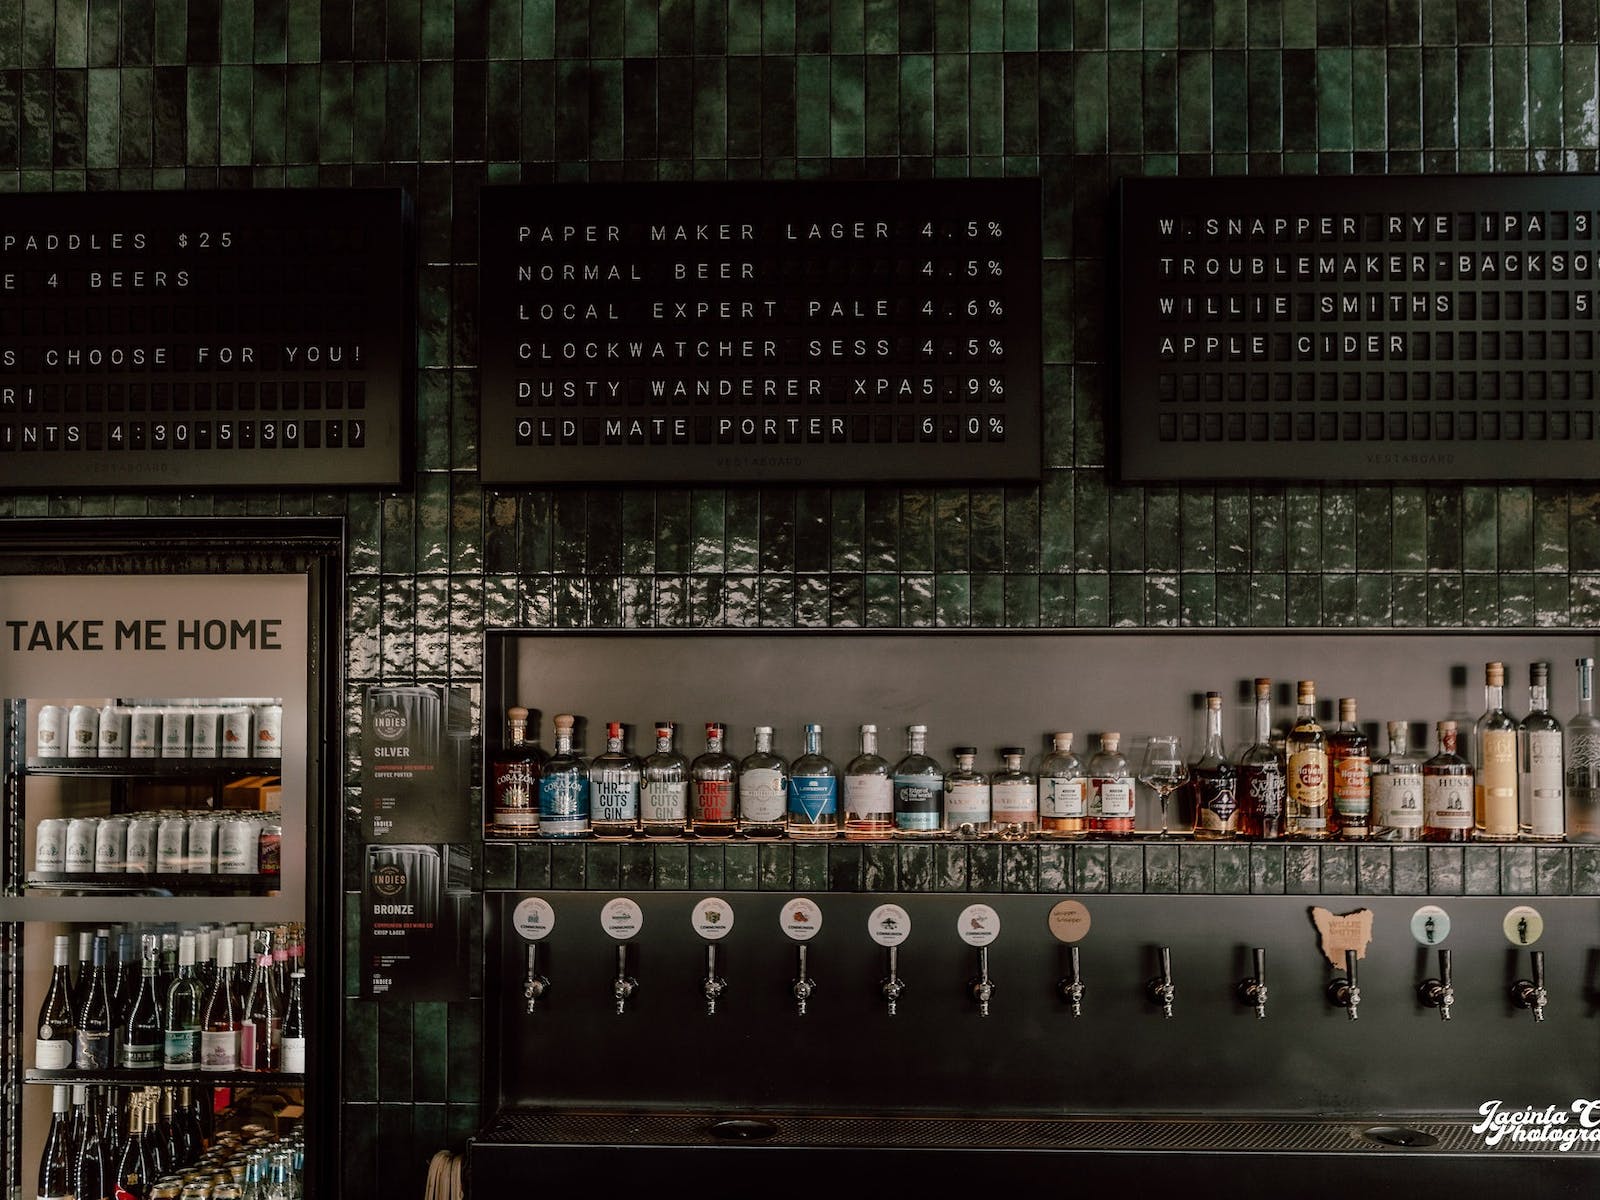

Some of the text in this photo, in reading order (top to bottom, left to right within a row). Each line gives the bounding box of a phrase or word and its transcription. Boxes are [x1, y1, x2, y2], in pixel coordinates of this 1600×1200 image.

[520, 221, 1004, 242] PAPER MAKER LAGER 4.5%
[1159, 215, 1588, 235] W.SNAPPER RYE IPA 3
[4, 232, 232, 250] PADDLES $25
[519, 260, 1004, 281] NORMAL BEER 4.5%
[1160, 255, 1600, 275] TROUBLEMAKER-BACKSO
[47, 273, 58, 288] 4
[91, 271, 189, 288] BEERS
[519, 299, 1004, 320] LOCAL EXPERT PALE 4.6%
[1159, 295, 1588, 314] WILLIE SMITHS 5
[519, 338, 1004, 359] CLOCKWATCHER SESS 4.5%
[1161, 336, 1404, 354] APPLE CIDER
[46, 348, 166, 366] CHOOSE
[199, 347, 255, 363] FOR
[286, 346, 359, 362] YOU!
[519, 381, 621, 398] DUSTY
[651, 379, 821, 396] WANDERER
[111, 423, 297, 442] 4:30-5:30
[518, 417, 1004, 437] OLD MATE PORTER 6.0%
[6, 619, 282, 651] TAKE ME HOME
[375, 718, 406, 728] INDIES
[374, 747, 410, 758] SILVER
[1438, 779, 1470, 788] HUSK
[600, 795, 627, 807] CUTS
[651, 795, 679, 807] CUTS
[699, 795, 727, 807] CUTS
[604, 808, 622, 820] GIN
[656, 808, 674, 820] GIN
[704, 808, 722, 820] GIN
[374, 875, 406, 885] INDIES
[373, 904, 415, 915] BRONZE
